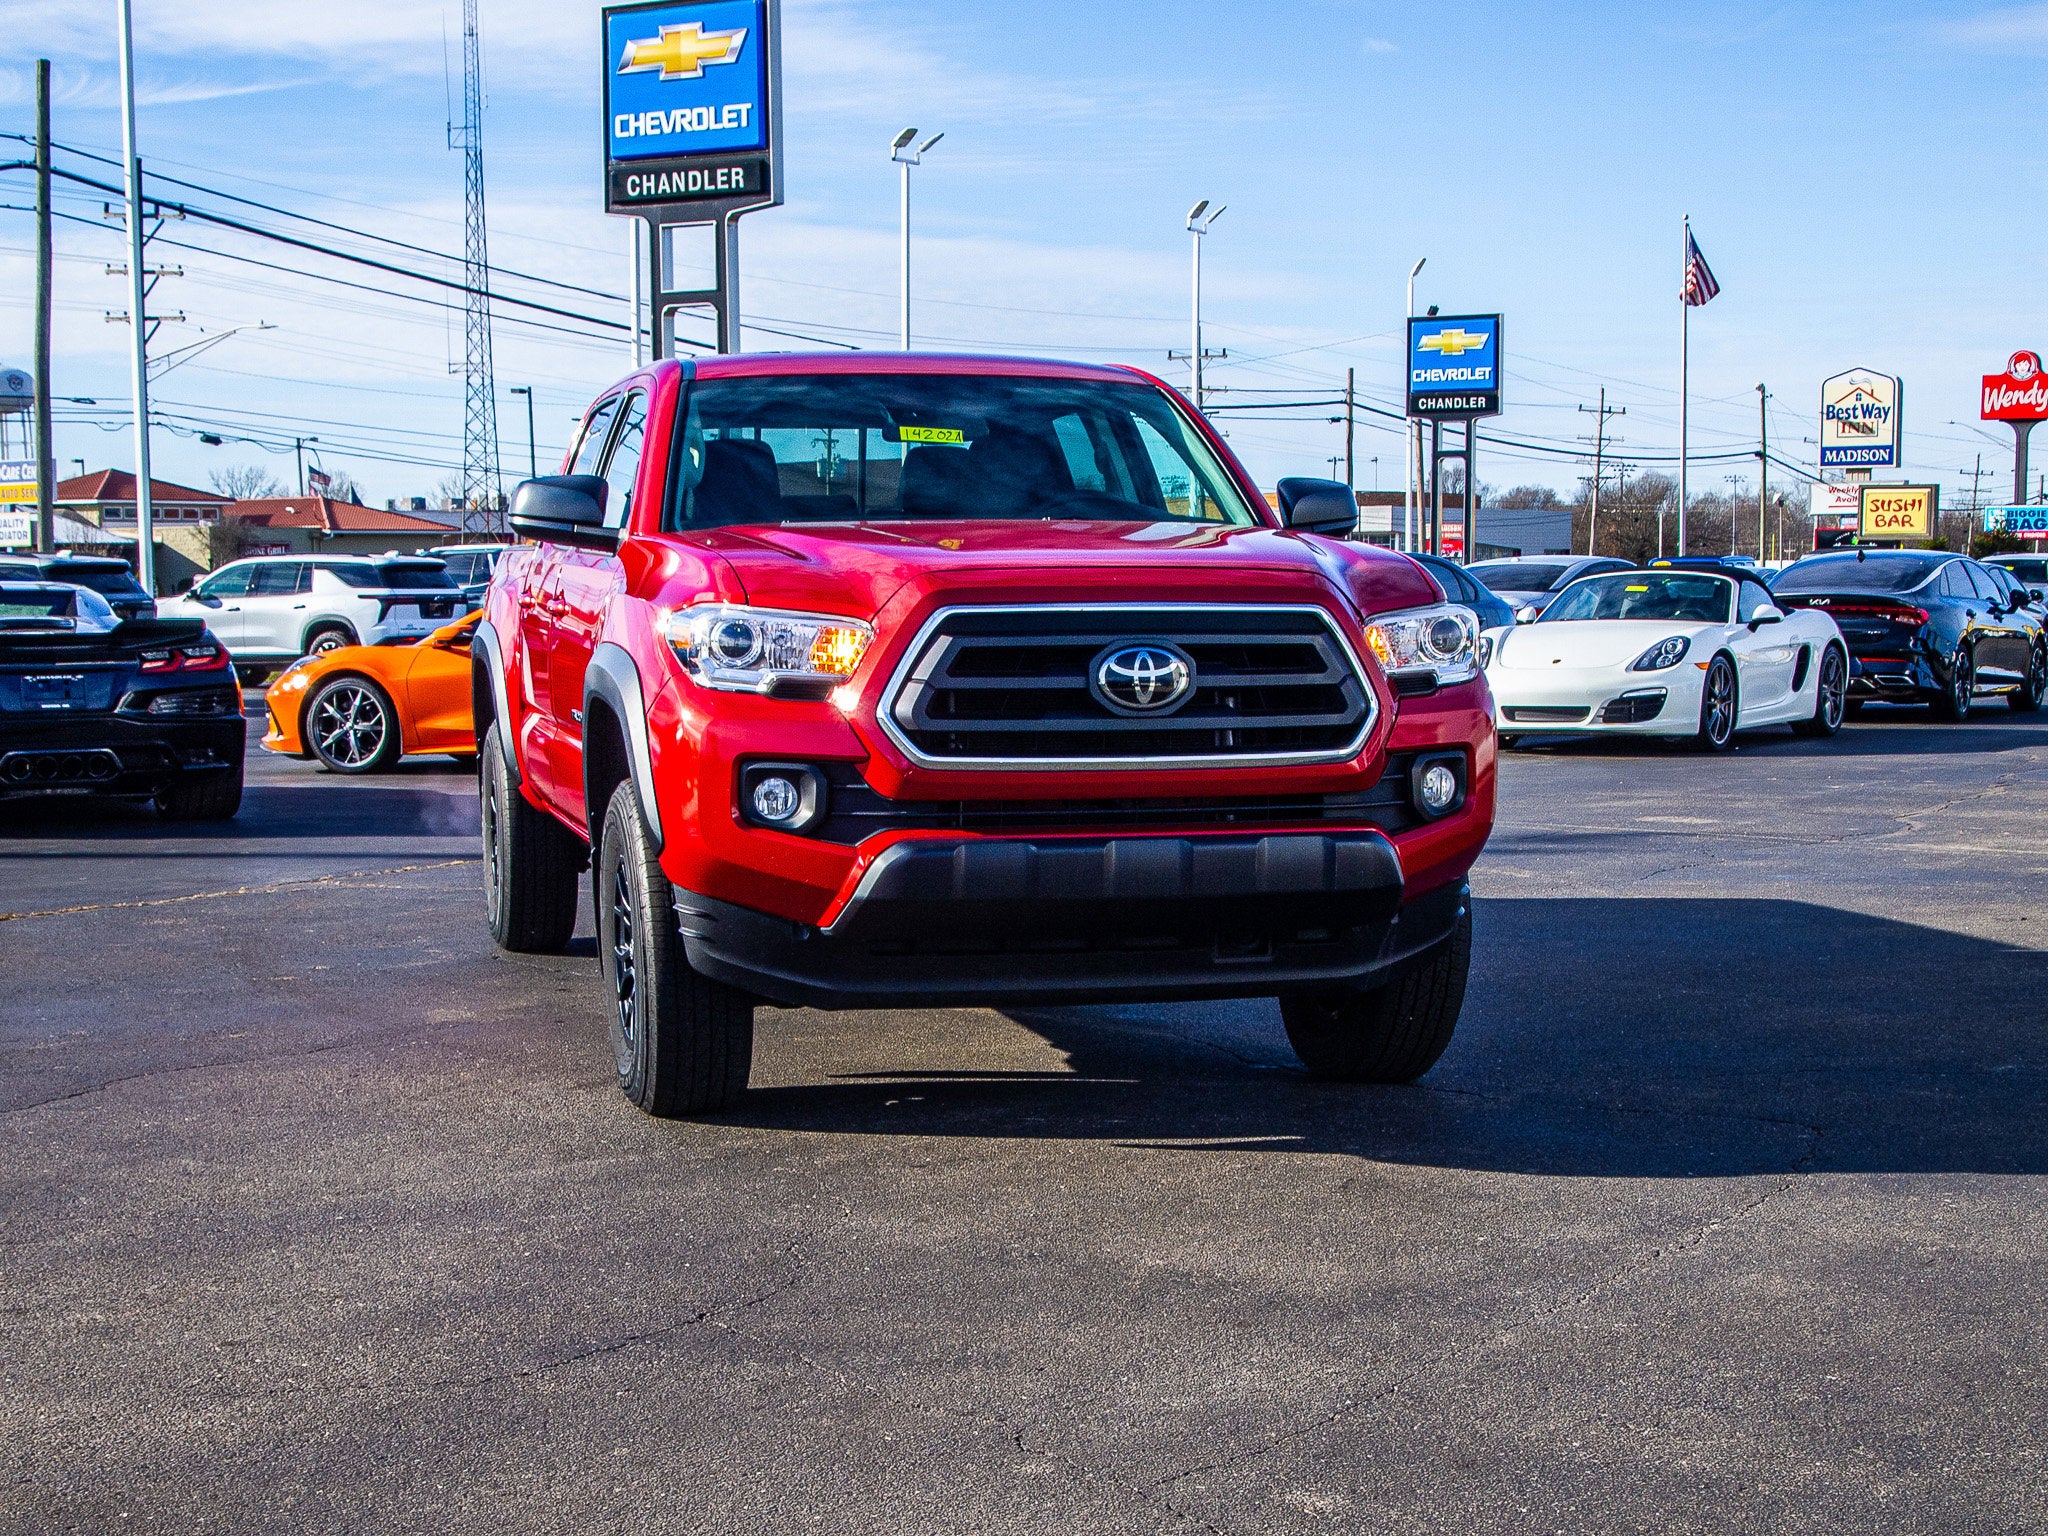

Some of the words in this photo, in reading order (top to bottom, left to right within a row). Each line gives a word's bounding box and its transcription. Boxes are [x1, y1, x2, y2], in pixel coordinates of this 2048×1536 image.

[614, 102, 752, 138] CHEVROLET
[626, 167, 745, 197] CHANDLER
[1412, 366, 1492, 382] CHEVROLET
[1418, 396, 1486, 410] CHANDLER
[1983, 379, 2048, 414] Wendy
[1826, 403, 1859, 420] Best
[1860, 402, 1891, 424] Way
[1840, 421, 1876, 434] INN
[905, 428, 962, 442] 14202A
[1824, 448, 1890, 463] MADISON
[2, 488, 19, 499] AUTO
[1869, 498, 1923, 513] SUSHI
[1874, 514, 1915, 528] BAR
[2006, 510, 2047, 518] BIGGIE
[2007, 518, 2047, 530] BAG
